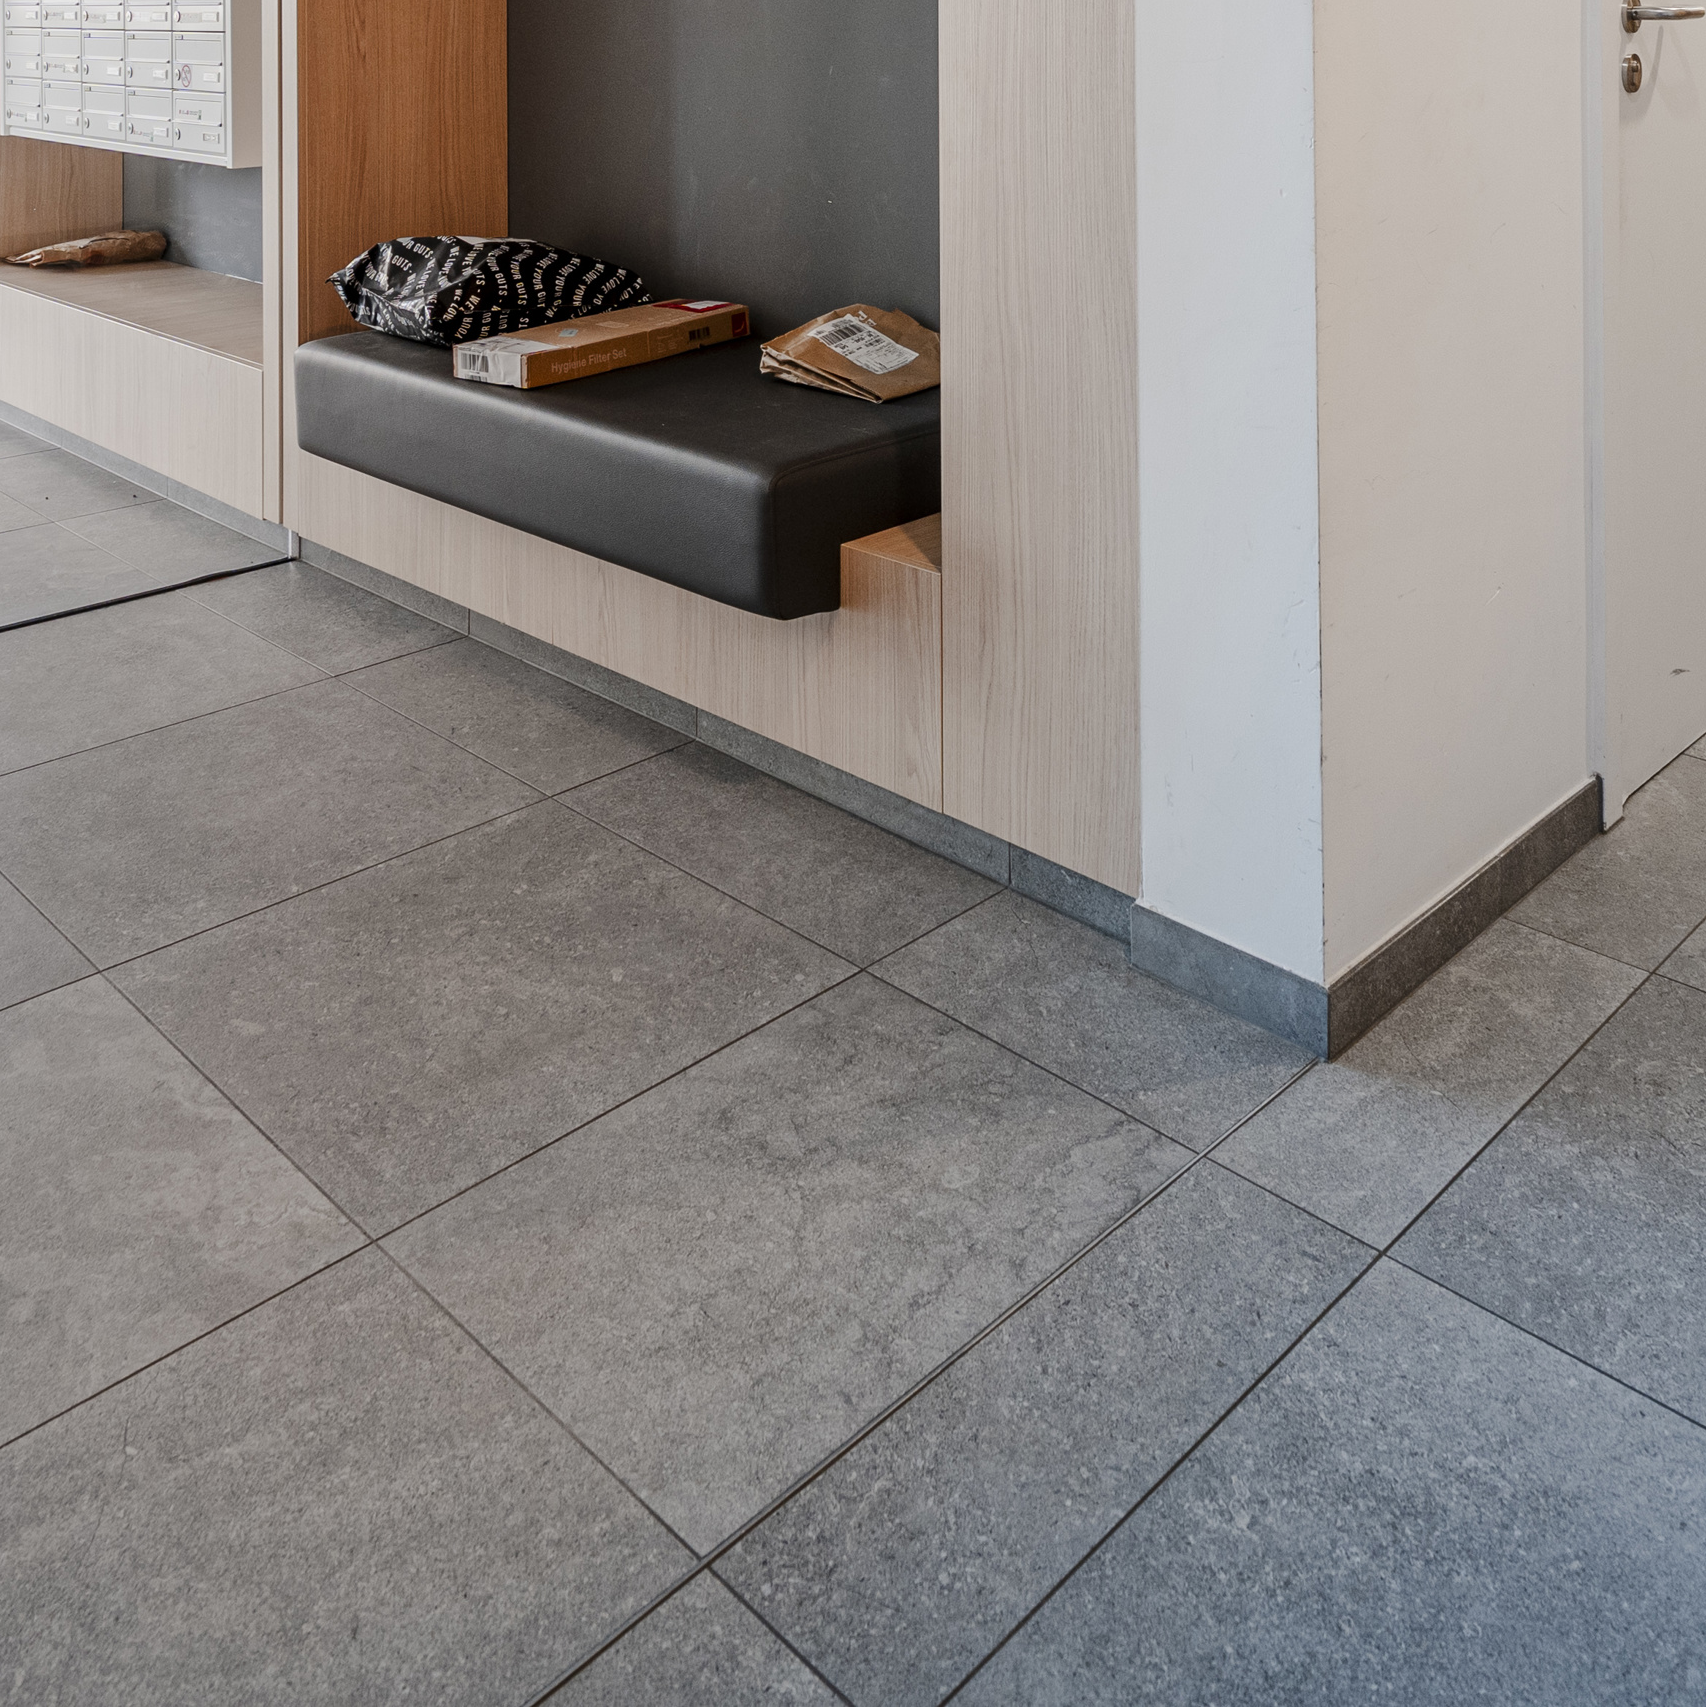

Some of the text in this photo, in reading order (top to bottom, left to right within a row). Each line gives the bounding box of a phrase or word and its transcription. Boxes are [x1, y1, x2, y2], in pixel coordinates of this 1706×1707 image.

[413, 243, 434, 259] GUTS
[391, 255, 412, 272] GUTS
[510, 260, 522, 280] YOUR
[473, 268, 486, 286] UTS
[494, 272, 508, 296] GUTS
[532, 267, 544, 291] YOUR
[616, 268, 627, 281] WE
[515, 281, 529, 305] GUTS
[554, 275, 566, 298] YOUR
[572, 263, 606, 307] WE LOVE YOUR
[600, 276, 621, 295] LOVE
[536, 291, 547, 308] GUT
[592, 293, 605, 305] YO
[454, 317, 474, 340] YOUR
[518, 317, 530, 329] TS
[551, 348, 627, 374] Hygiene Filter Set
